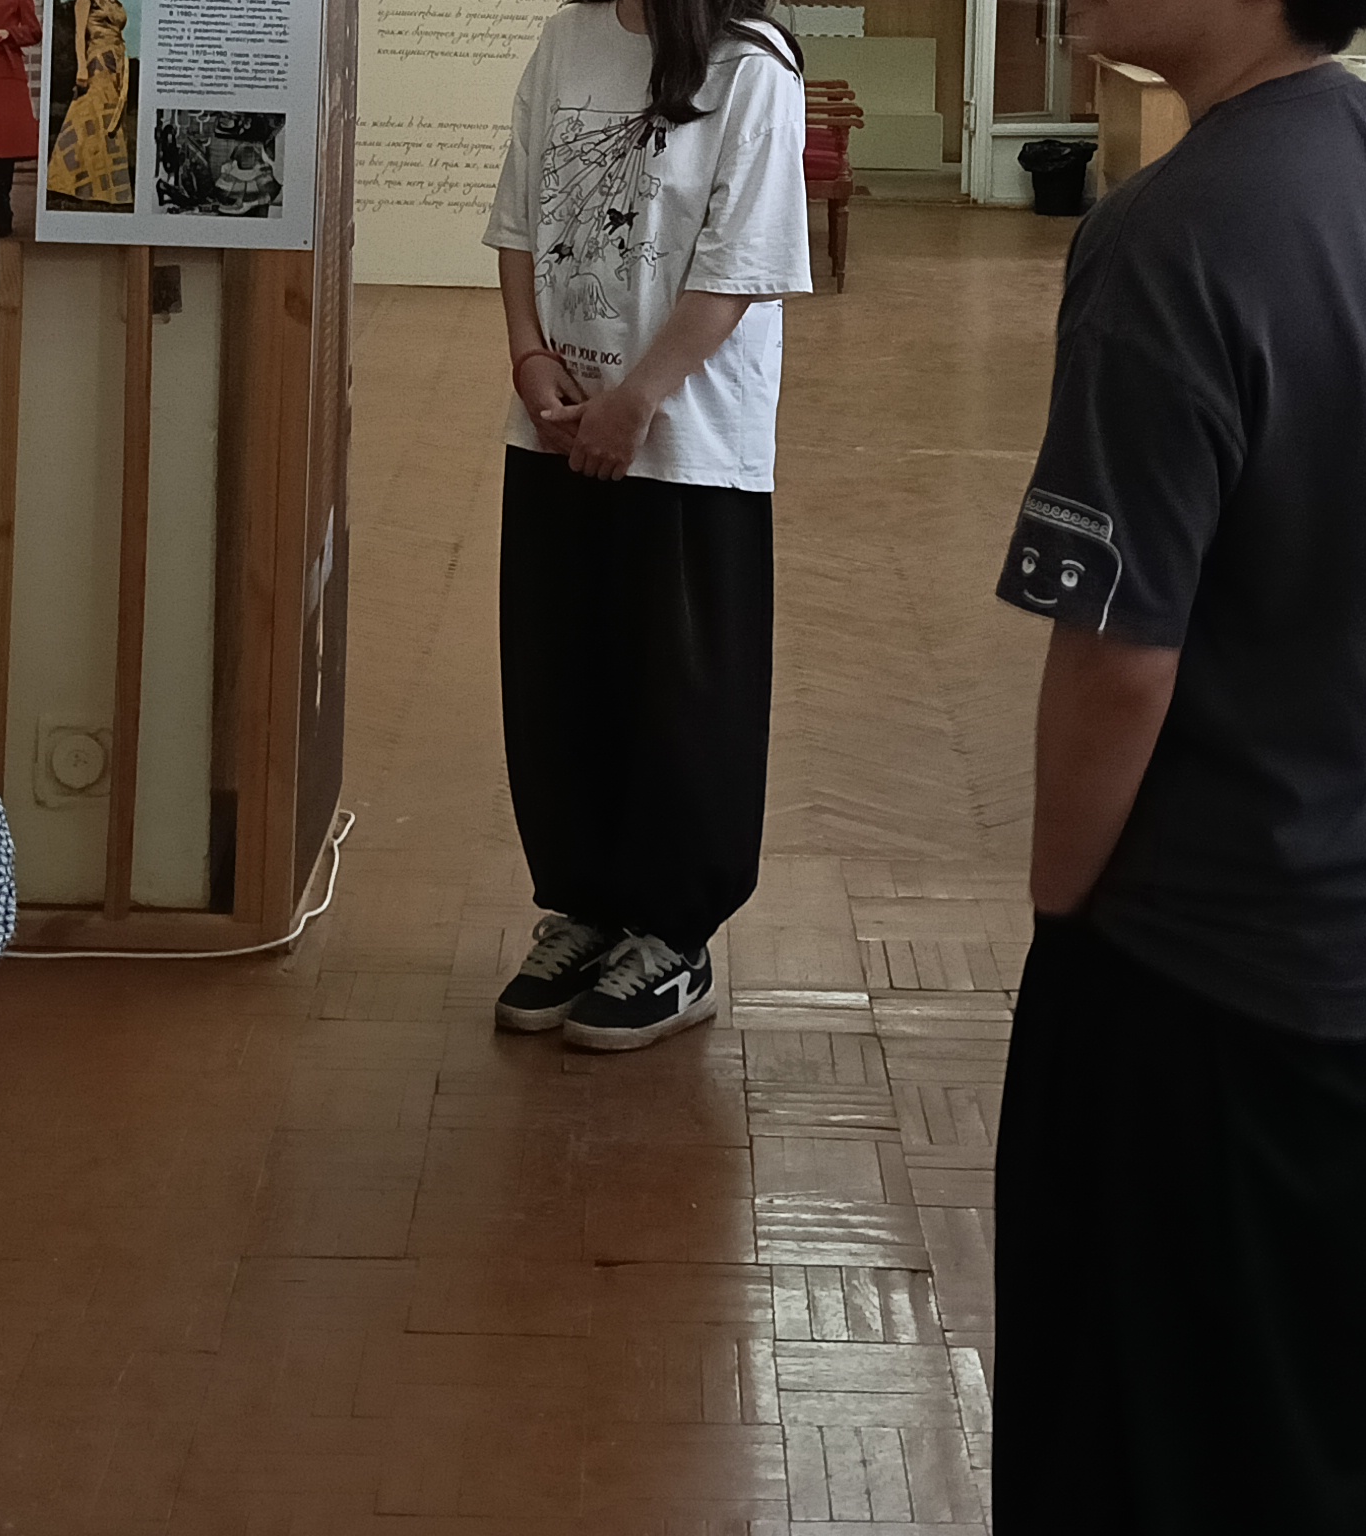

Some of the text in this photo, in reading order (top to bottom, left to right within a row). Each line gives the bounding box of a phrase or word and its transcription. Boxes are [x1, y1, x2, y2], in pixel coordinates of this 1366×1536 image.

[377, 5, 451, 22] излишествами
[412, 24, 455, 44] бороться
[377, 49, 469, 61] коммунистических
[437, 122, 488, 132] поточного
[373, 199, 415, 212] должна
[601, 351, 622, 365] DOG
